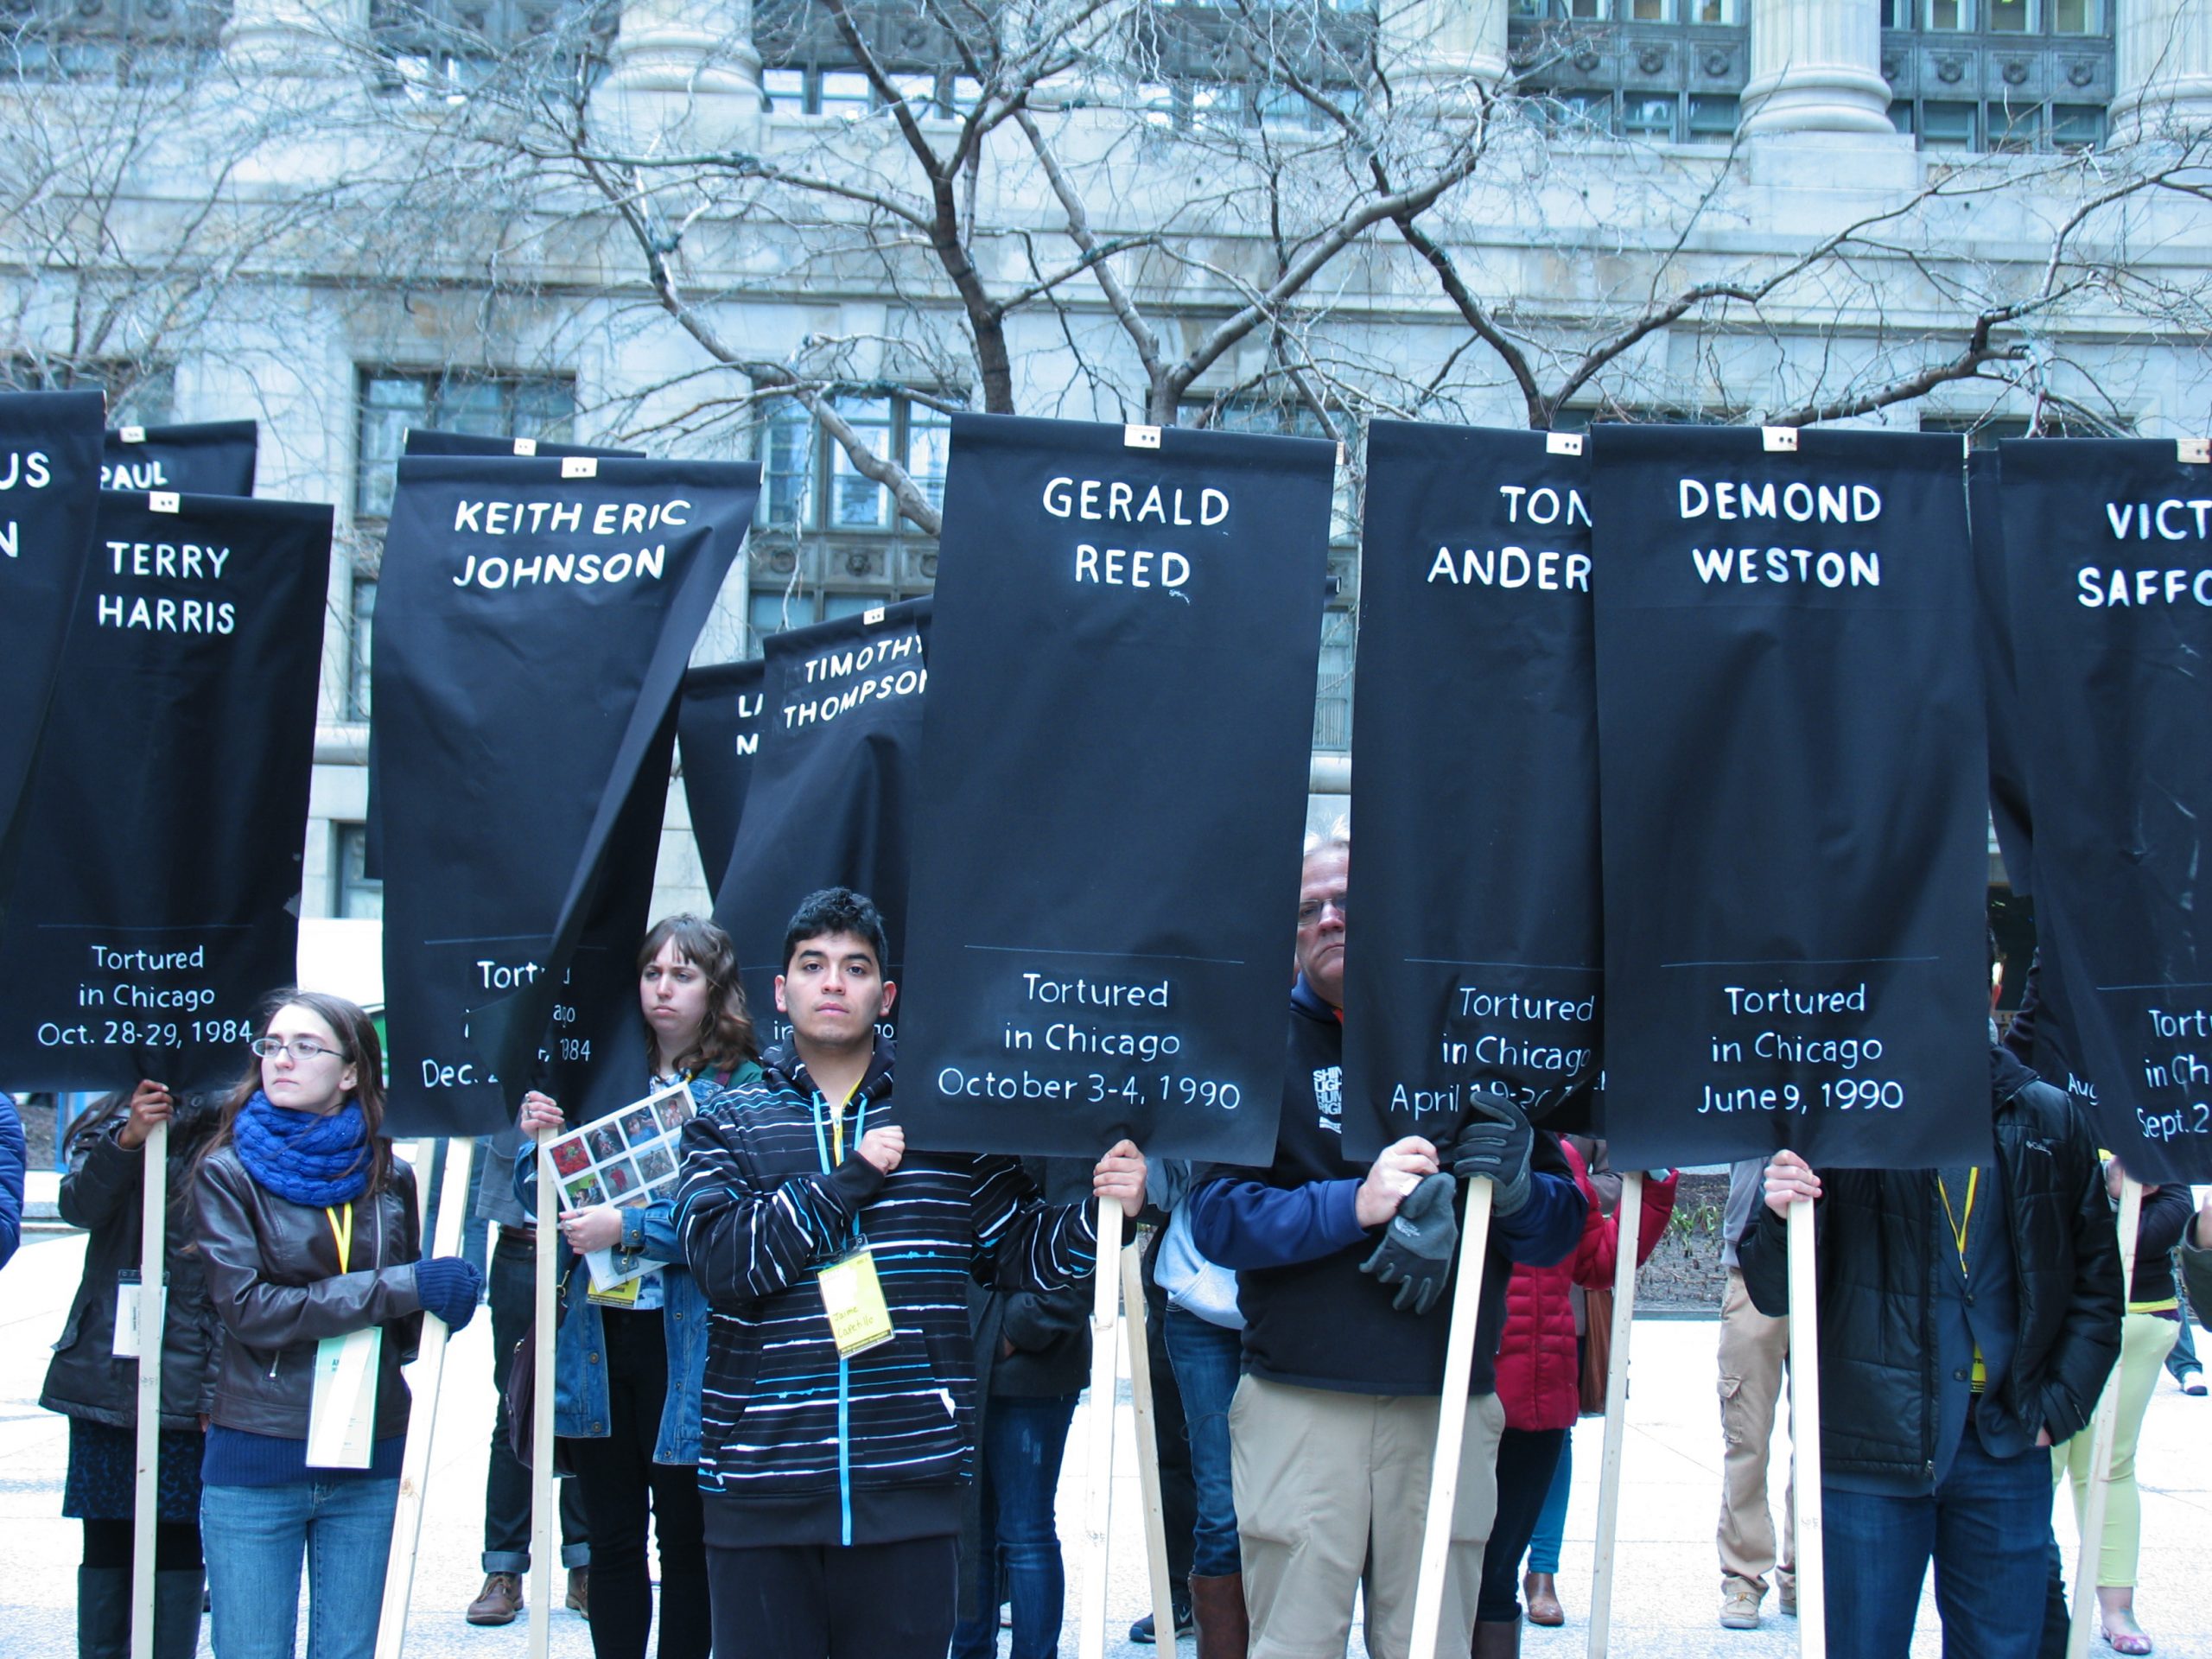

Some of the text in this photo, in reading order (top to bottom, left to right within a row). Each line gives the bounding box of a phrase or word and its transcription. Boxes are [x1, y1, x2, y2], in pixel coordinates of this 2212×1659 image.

[454, 499, 691, 535] KEITH ERIC
[1042, 476, 1230, 526] GERALD
[1679, 479, 1881, 524] DEMOND
[105, 541, 230, 579] TERRY
[453, 543, 665, 589] JOHNSON
[1075, 543, 1191, 588] REED
[1427, 546, 1592, 593] ANDER
[1692, 547, 1880, 588] WESTON
[99, 594, 235, 634] HARRIS
[91, 944, 204, 971] Tortured
[79, 983, 215, 1012] in Chicago
[1022, 973, 1168, 1007] Tortured
[1459, 987, 1594, 1021] Tortured
[1724, 982, 1866, 1015] Tortured
[37, 1019, 254, 1049] Oct. 28-29, 1984
[1005, 1021, 1180, 1062] in Chicago
[2148, 1009, 2212, 1037] Tort
[1443, 1033, 1590, 1077] in Chicago
[1712, 1032, 1883, 1070] in Chicago
[422, 1058, 479, 1088] Dec.
[938, 1067, 1241, 1109] October 3-4, 1990
[2145, 1053, 2209, 1088] in Ch
[1390, 1084, 1459, 1121] April
[1697, 1078, 1904, 1115] June 9, 1990
[2136, 1107, 2190, 1142] Sept.
